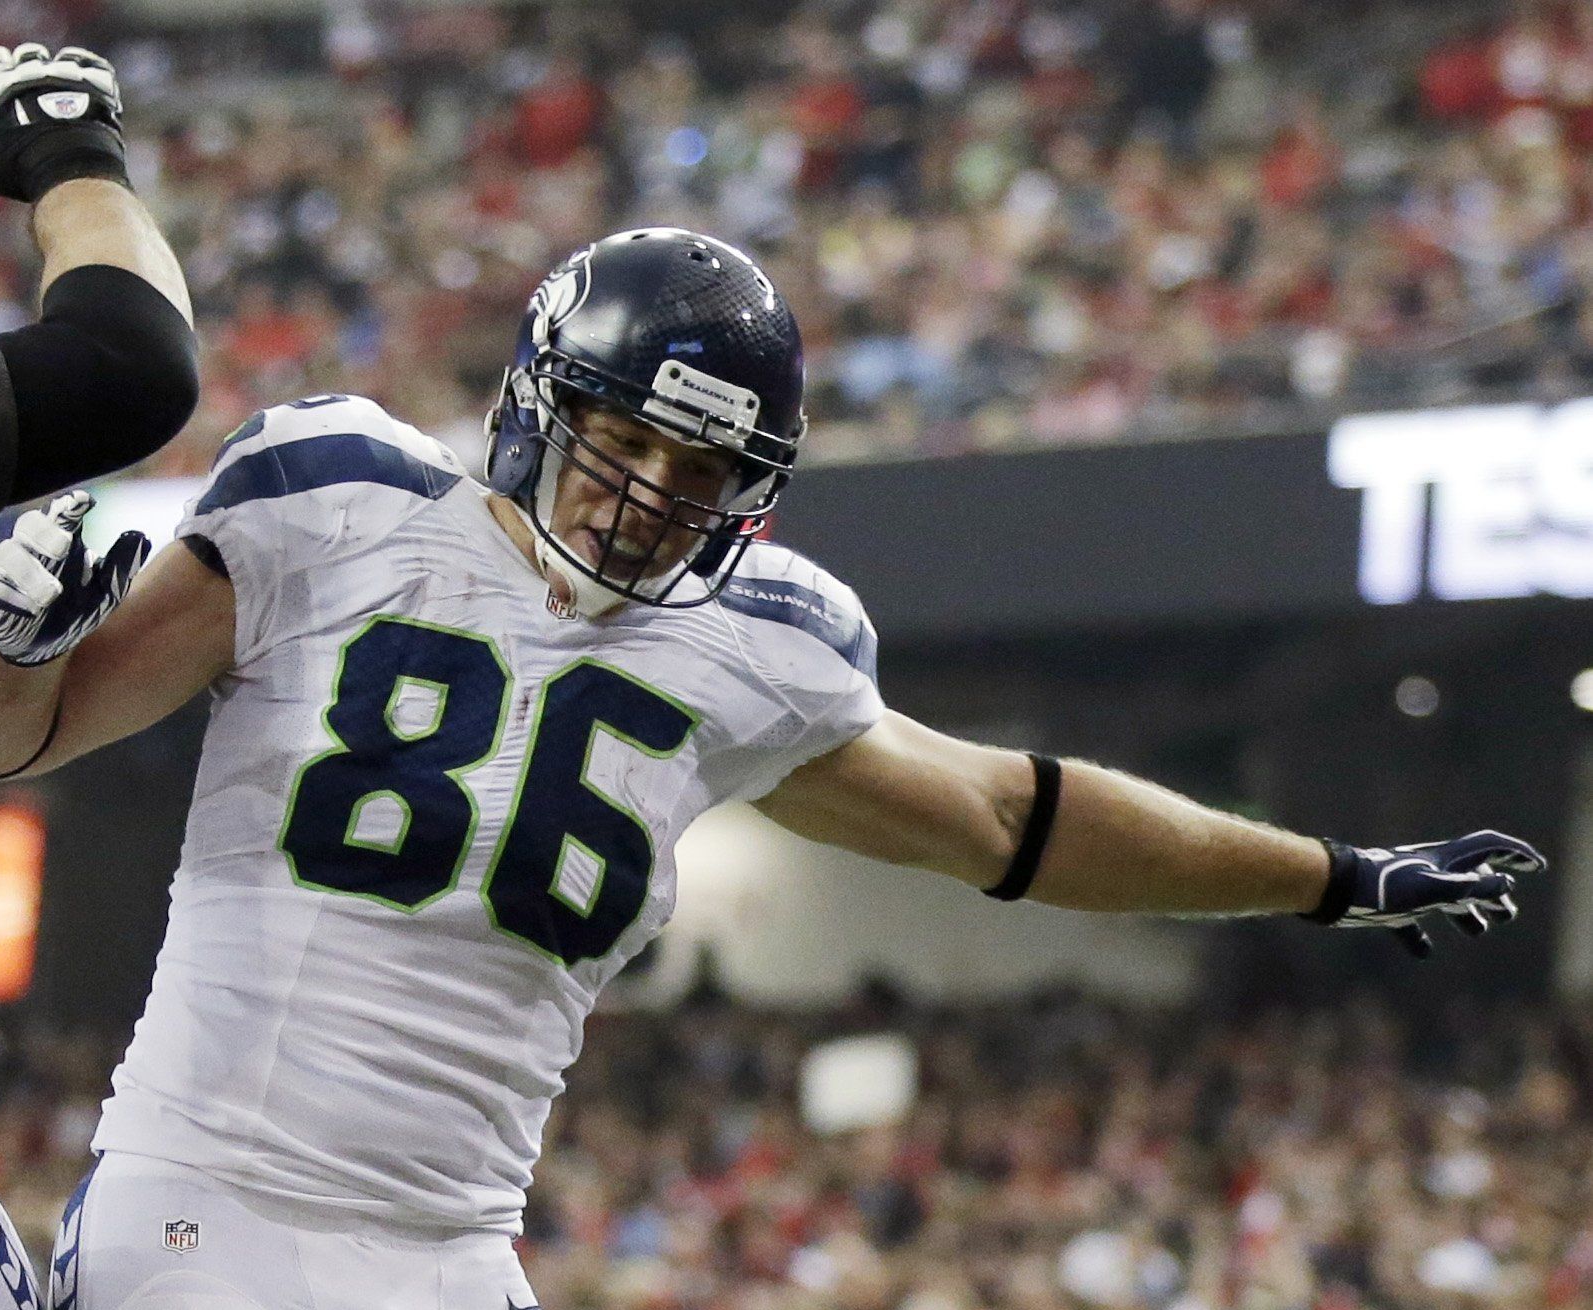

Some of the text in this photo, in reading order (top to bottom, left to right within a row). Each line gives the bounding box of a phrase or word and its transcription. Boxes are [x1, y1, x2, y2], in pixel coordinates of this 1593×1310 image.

[681, 379, 735, 405] SEAHAWKS
[547, 595, 574, 619] NFL
[728, 583, 837, 626] SEAHAWKS
[275, 612, 702, 966] 86
[168, 1232, 195, 1248] NFL
